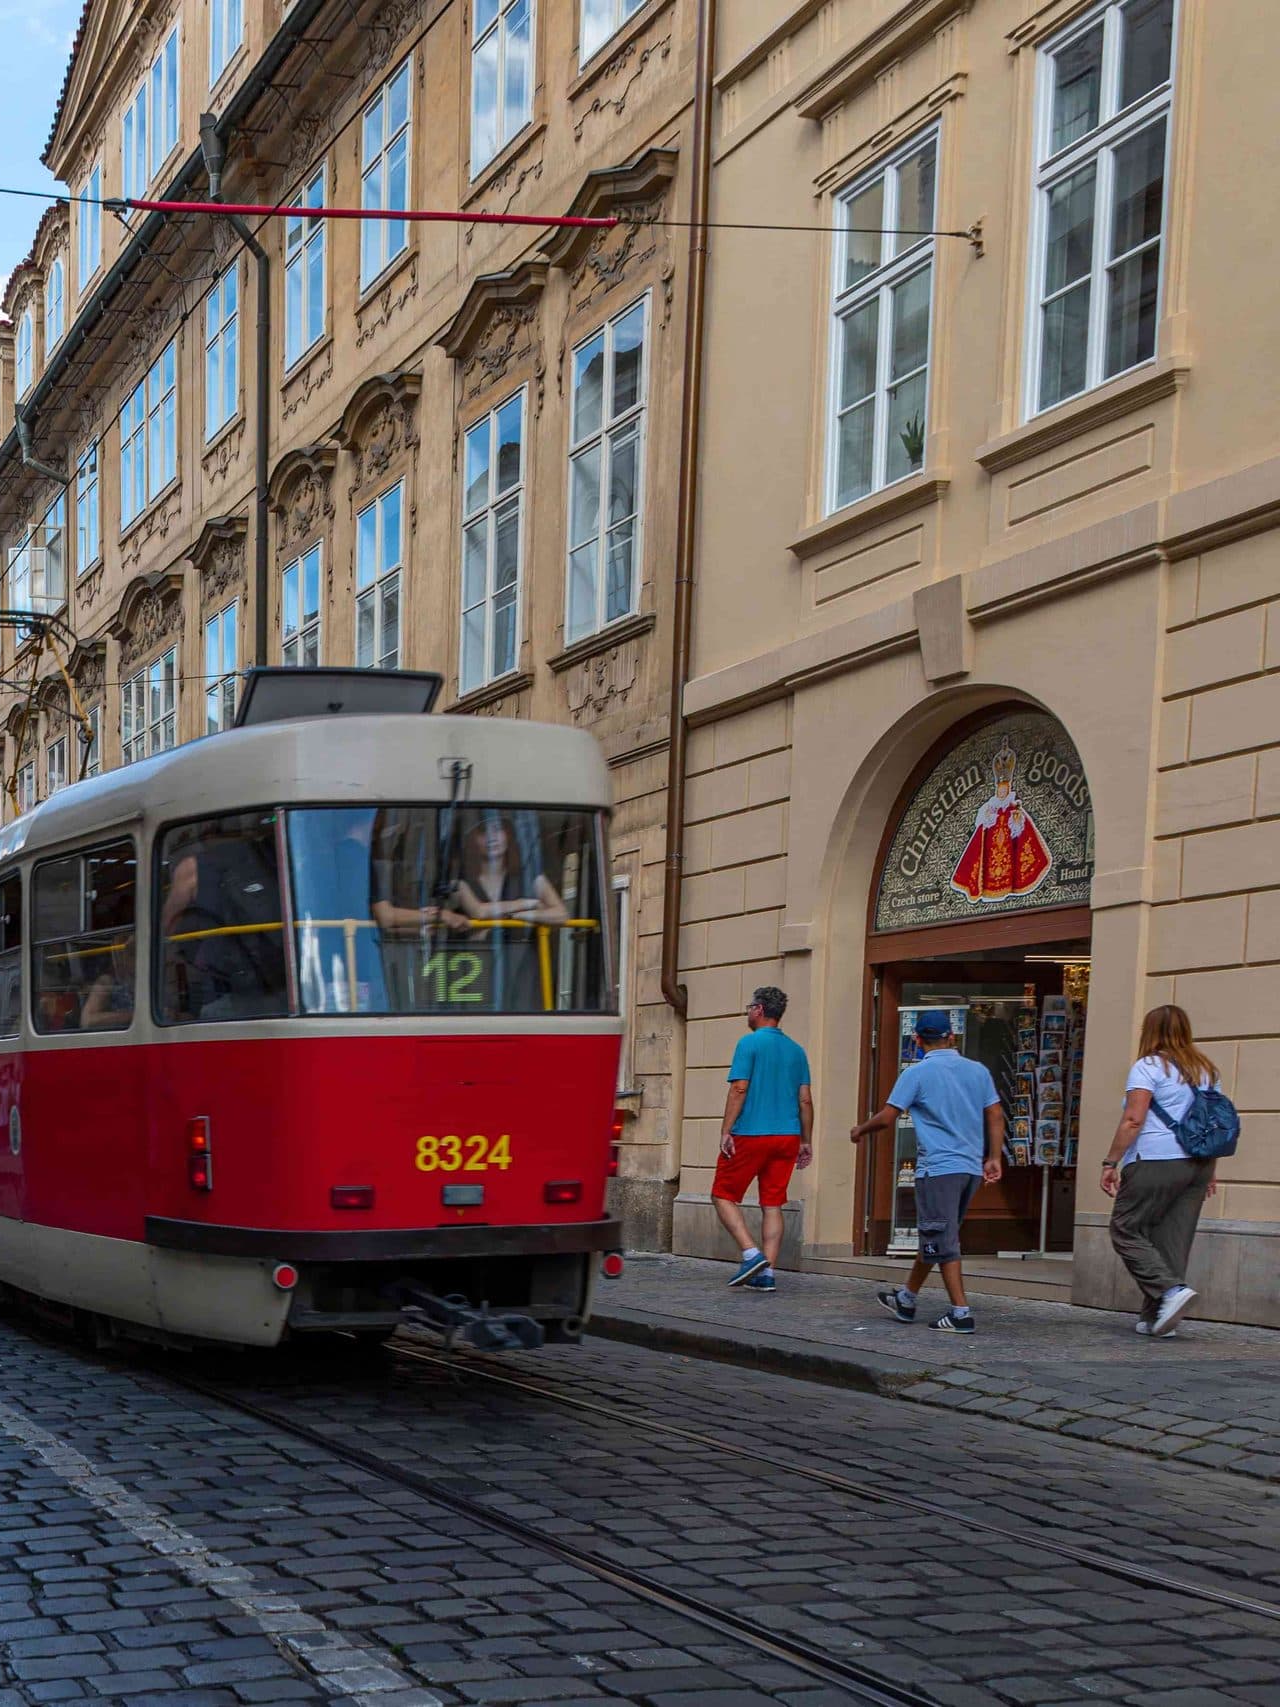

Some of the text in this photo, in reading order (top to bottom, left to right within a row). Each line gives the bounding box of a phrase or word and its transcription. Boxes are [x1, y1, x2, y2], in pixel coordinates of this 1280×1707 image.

[901, 751, 1089, 876] Christian goods
[1060, 865, 1089, 881] Hand
[891, 892, 940, 908] Czech store
[422, 953, 484, 1002] 12
[415, 1135, 513, 1171] 8324
